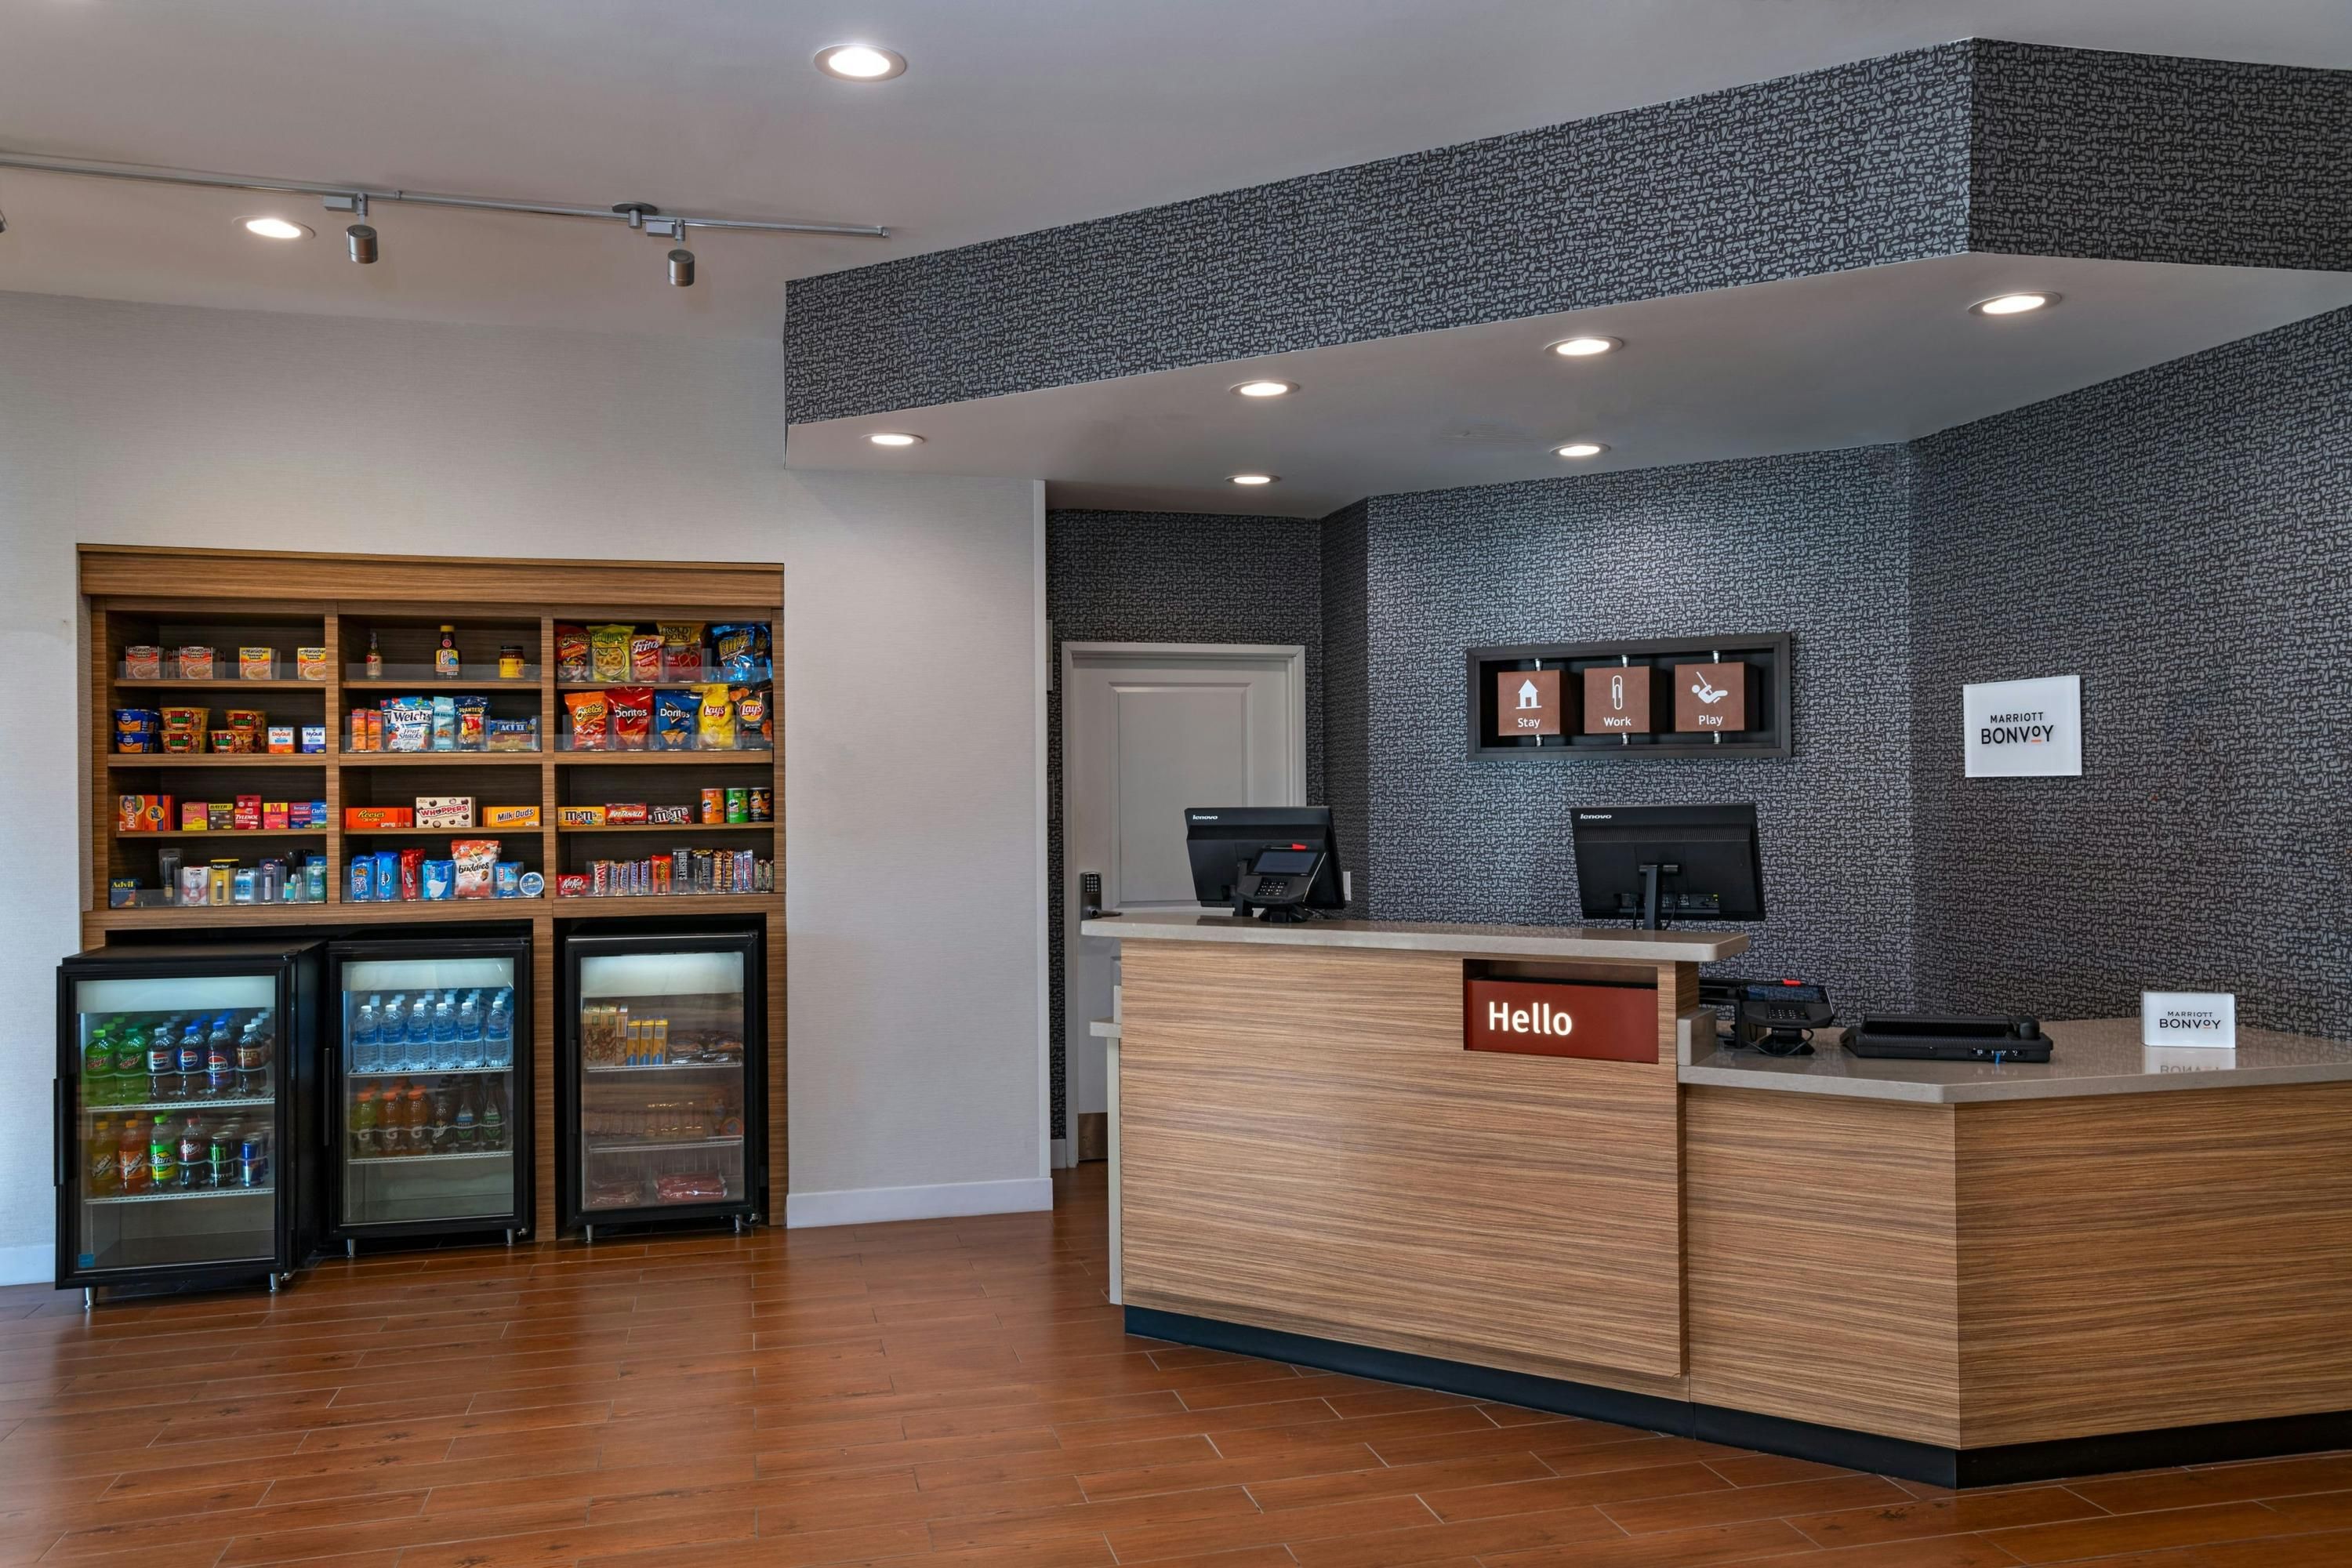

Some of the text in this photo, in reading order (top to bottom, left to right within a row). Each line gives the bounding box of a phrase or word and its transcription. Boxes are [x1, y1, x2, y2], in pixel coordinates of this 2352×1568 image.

[632, 640, 660, 654] Fritos
[615, 709, 648, 718] Doritos
[660, 708, 690, 718] Doritos
[705, 706, 725, 717] Lay's
[741, 705, 762, 716] Lay's
[394, 712, 432, 722] Welch's
[1518, 717, 1541, 728] Stay
[1604, 717, 1632, 727] Work
[1699, 714, 1722, 726] Play
[1991, 712, 2044, 724] MARRIOTT
[1981, 724, 2054, 744] BONVOY
[126, 800, 136, 828] bounce
[150, 807, 162, 820] Tide
[421, 805, 468, 816] WHOPPERS
[497, 808, 534, 822] Milk Duds
[458, 862, 489, 873] buddies
[678, 851, 688, 880] HERSHEY'S
[713, 858, 722, 887] HEATH
[724, 858, 733, 887] HEATH
[1488, 1001, 1573, 1036] Hello
[2159, 1018, 2221, 1029] BONVOY
[358, 1129, 370, 1141] G
[386, 1127, 397, 1139] G
[411, 1126, 423, 1138] G
